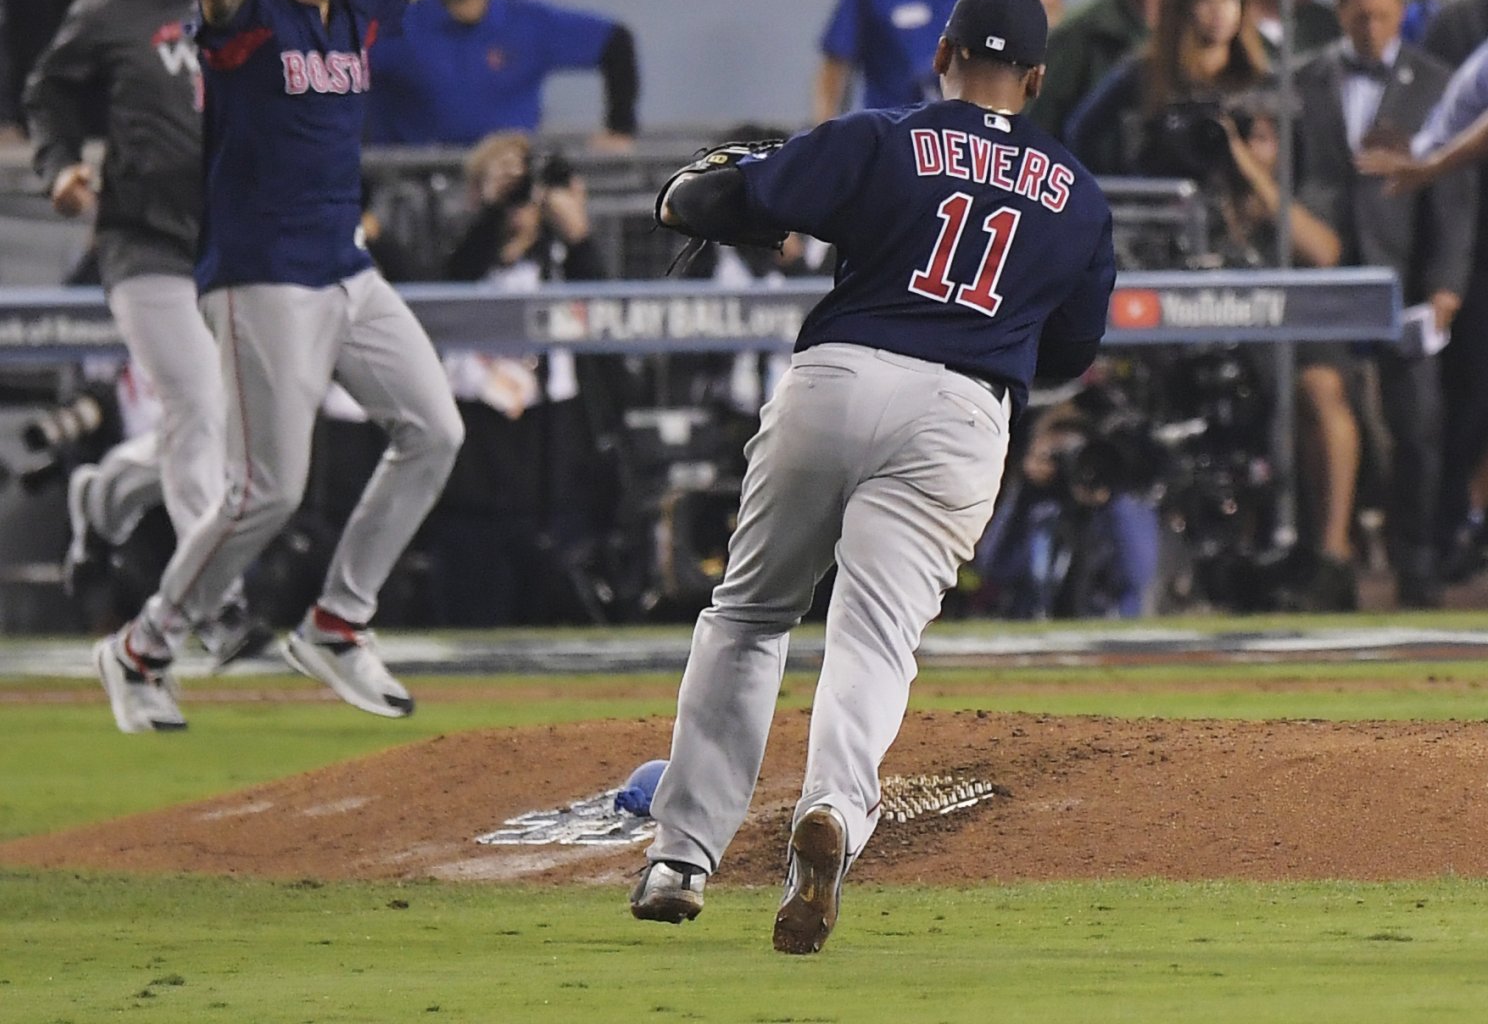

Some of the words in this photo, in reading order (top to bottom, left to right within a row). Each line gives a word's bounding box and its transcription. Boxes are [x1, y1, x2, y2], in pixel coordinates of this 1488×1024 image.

[280, 48, 371, 96] BOST
[910, 128, 1075, 214] DEVERS
[907, 191, 1022, 317] 11
